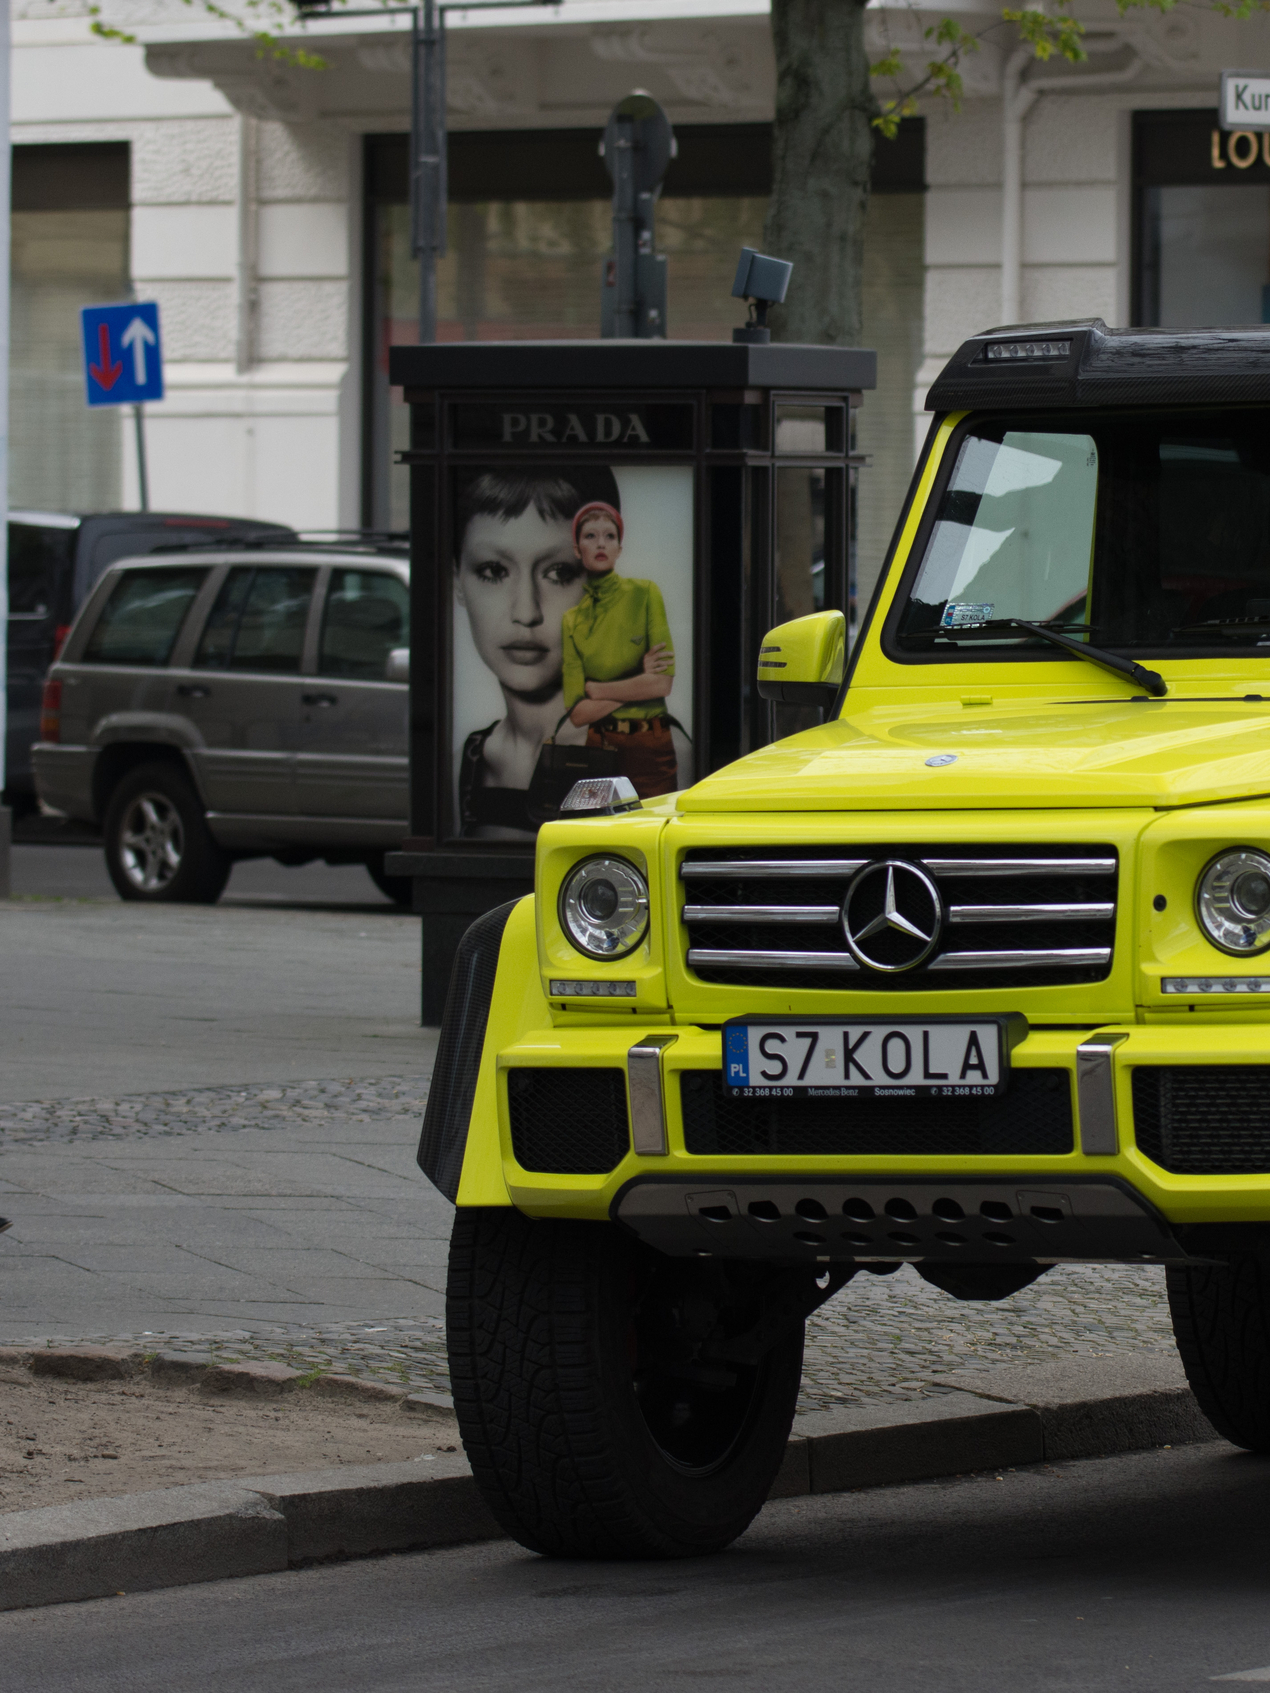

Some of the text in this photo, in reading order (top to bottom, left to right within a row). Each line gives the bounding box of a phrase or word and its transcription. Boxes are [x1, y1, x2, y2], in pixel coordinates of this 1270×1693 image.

[502, 413, 651, 443] PRADA
[759, 1030, 989, 1081] S7 KOLA
[730, 1063, 747, 1077] PL
[743, 1086, 995, 1096] 32 368 45 00 Mercedes-Benz Sosnowiec 32 368 45 00
